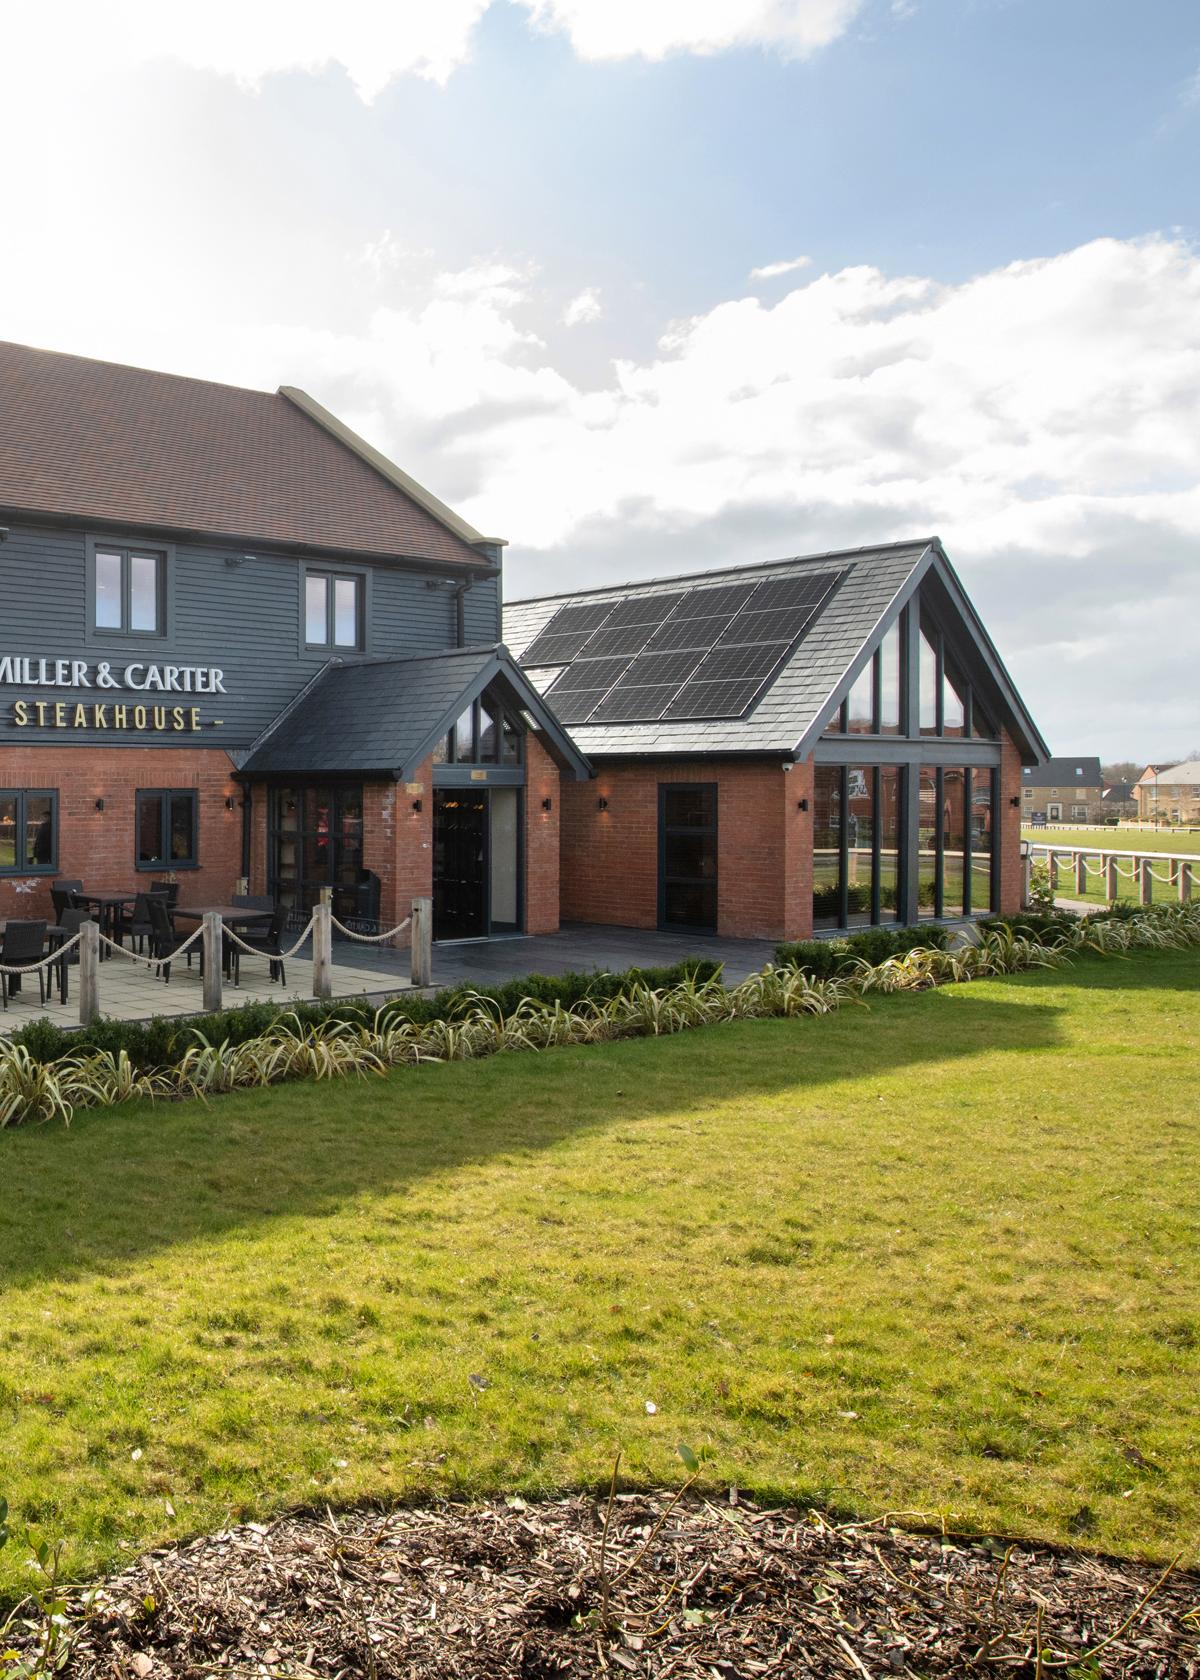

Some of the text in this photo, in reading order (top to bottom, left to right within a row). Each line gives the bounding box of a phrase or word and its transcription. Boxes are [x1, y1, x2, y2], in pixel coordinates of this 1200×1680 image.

[96, 662, 123, 689] &
[124, 663, 228, 694] CARTER
[15, 700, 202, 731] STEAKHOUSE
